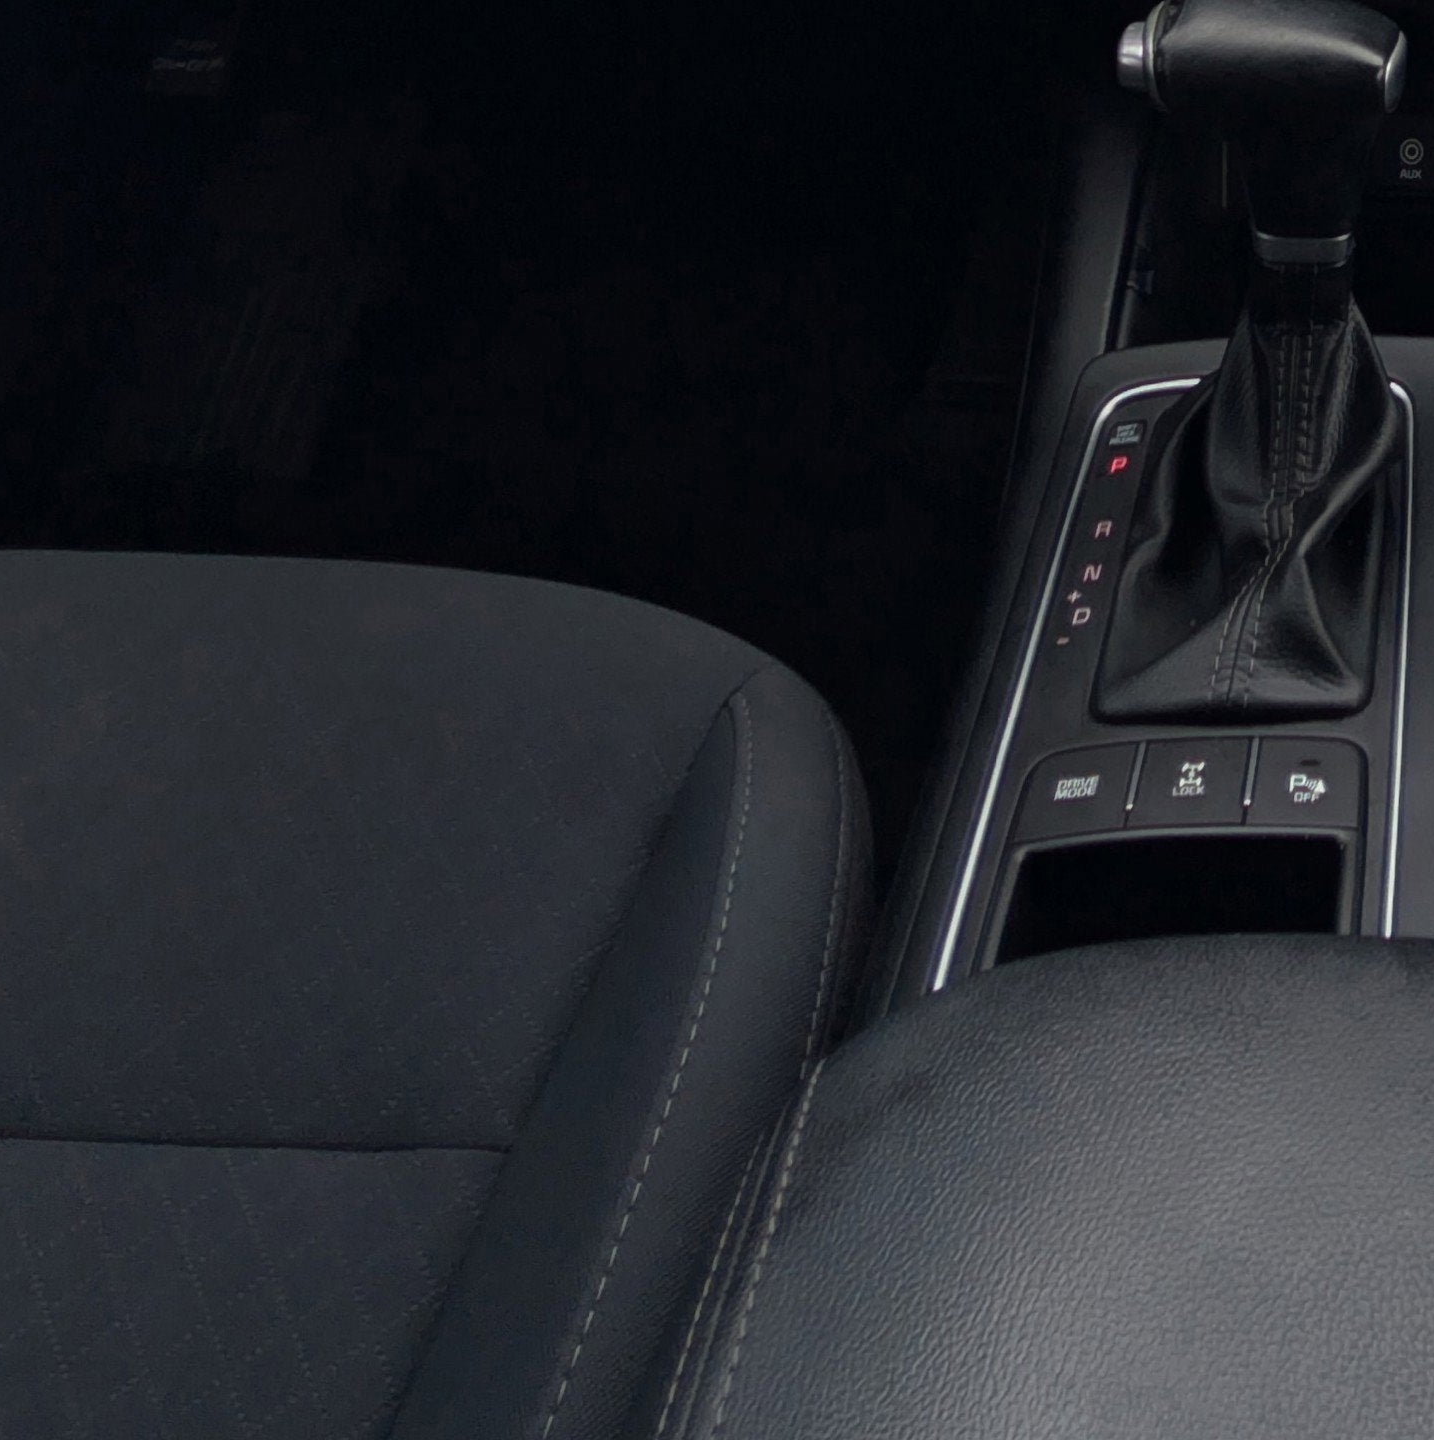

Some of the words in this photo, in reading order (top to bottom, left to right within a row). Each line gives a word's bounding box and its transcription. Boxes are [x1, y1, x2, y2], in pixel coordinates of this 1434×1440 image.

[1399, 167, 1423, 180] AUX
[1110, 455, 1128, 473] P
[1094, 520, 1113, 539] R
[1082, 564, 1103, 582] N
[1071, 606, 1092, 626] D
[1058, 775, 1100, 789] DRIVE
[1054, 786, 1098, 801] MODE
[1172, 786, 1206, 797] LOCK
[1293, 792, 1322, 803] OFF
